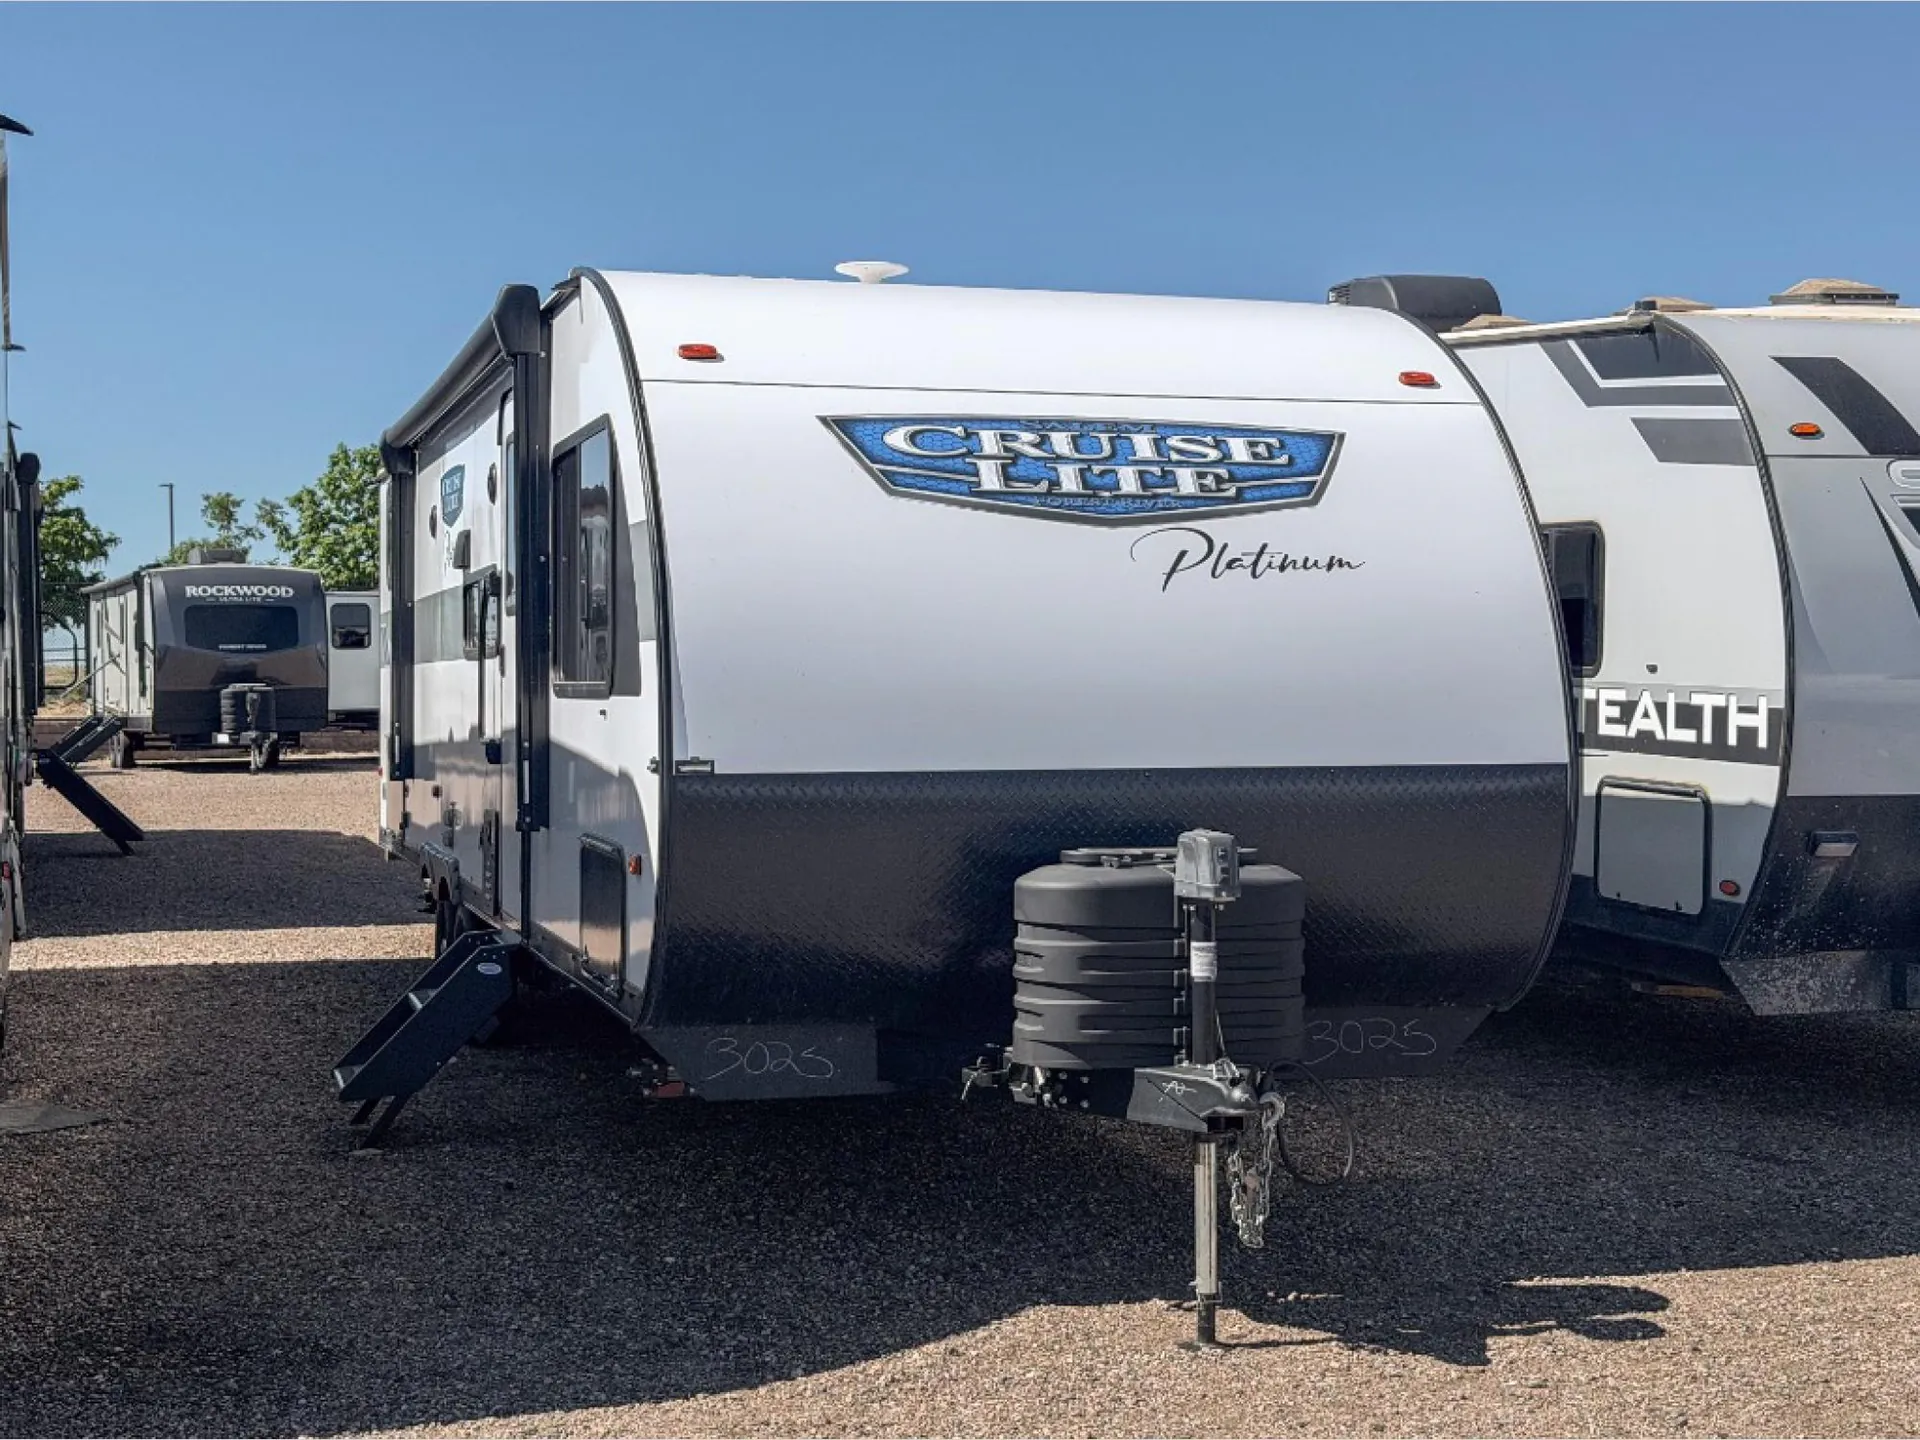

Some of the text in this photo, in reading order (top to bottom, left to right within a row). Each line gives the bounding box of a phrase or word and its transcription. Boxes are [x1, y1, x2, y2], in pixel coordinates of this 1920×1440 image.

[882, 425, 1289, 465] CRUISE
[965, 458, 1237, 498] LITE
[1130, 527, 1366, 592] Platinum
[184, 585, 295, 598] ROCKWOOD
[705, 1037, 834, 1080] 3025
[1302, 1017, 1437, 1065] 3025
